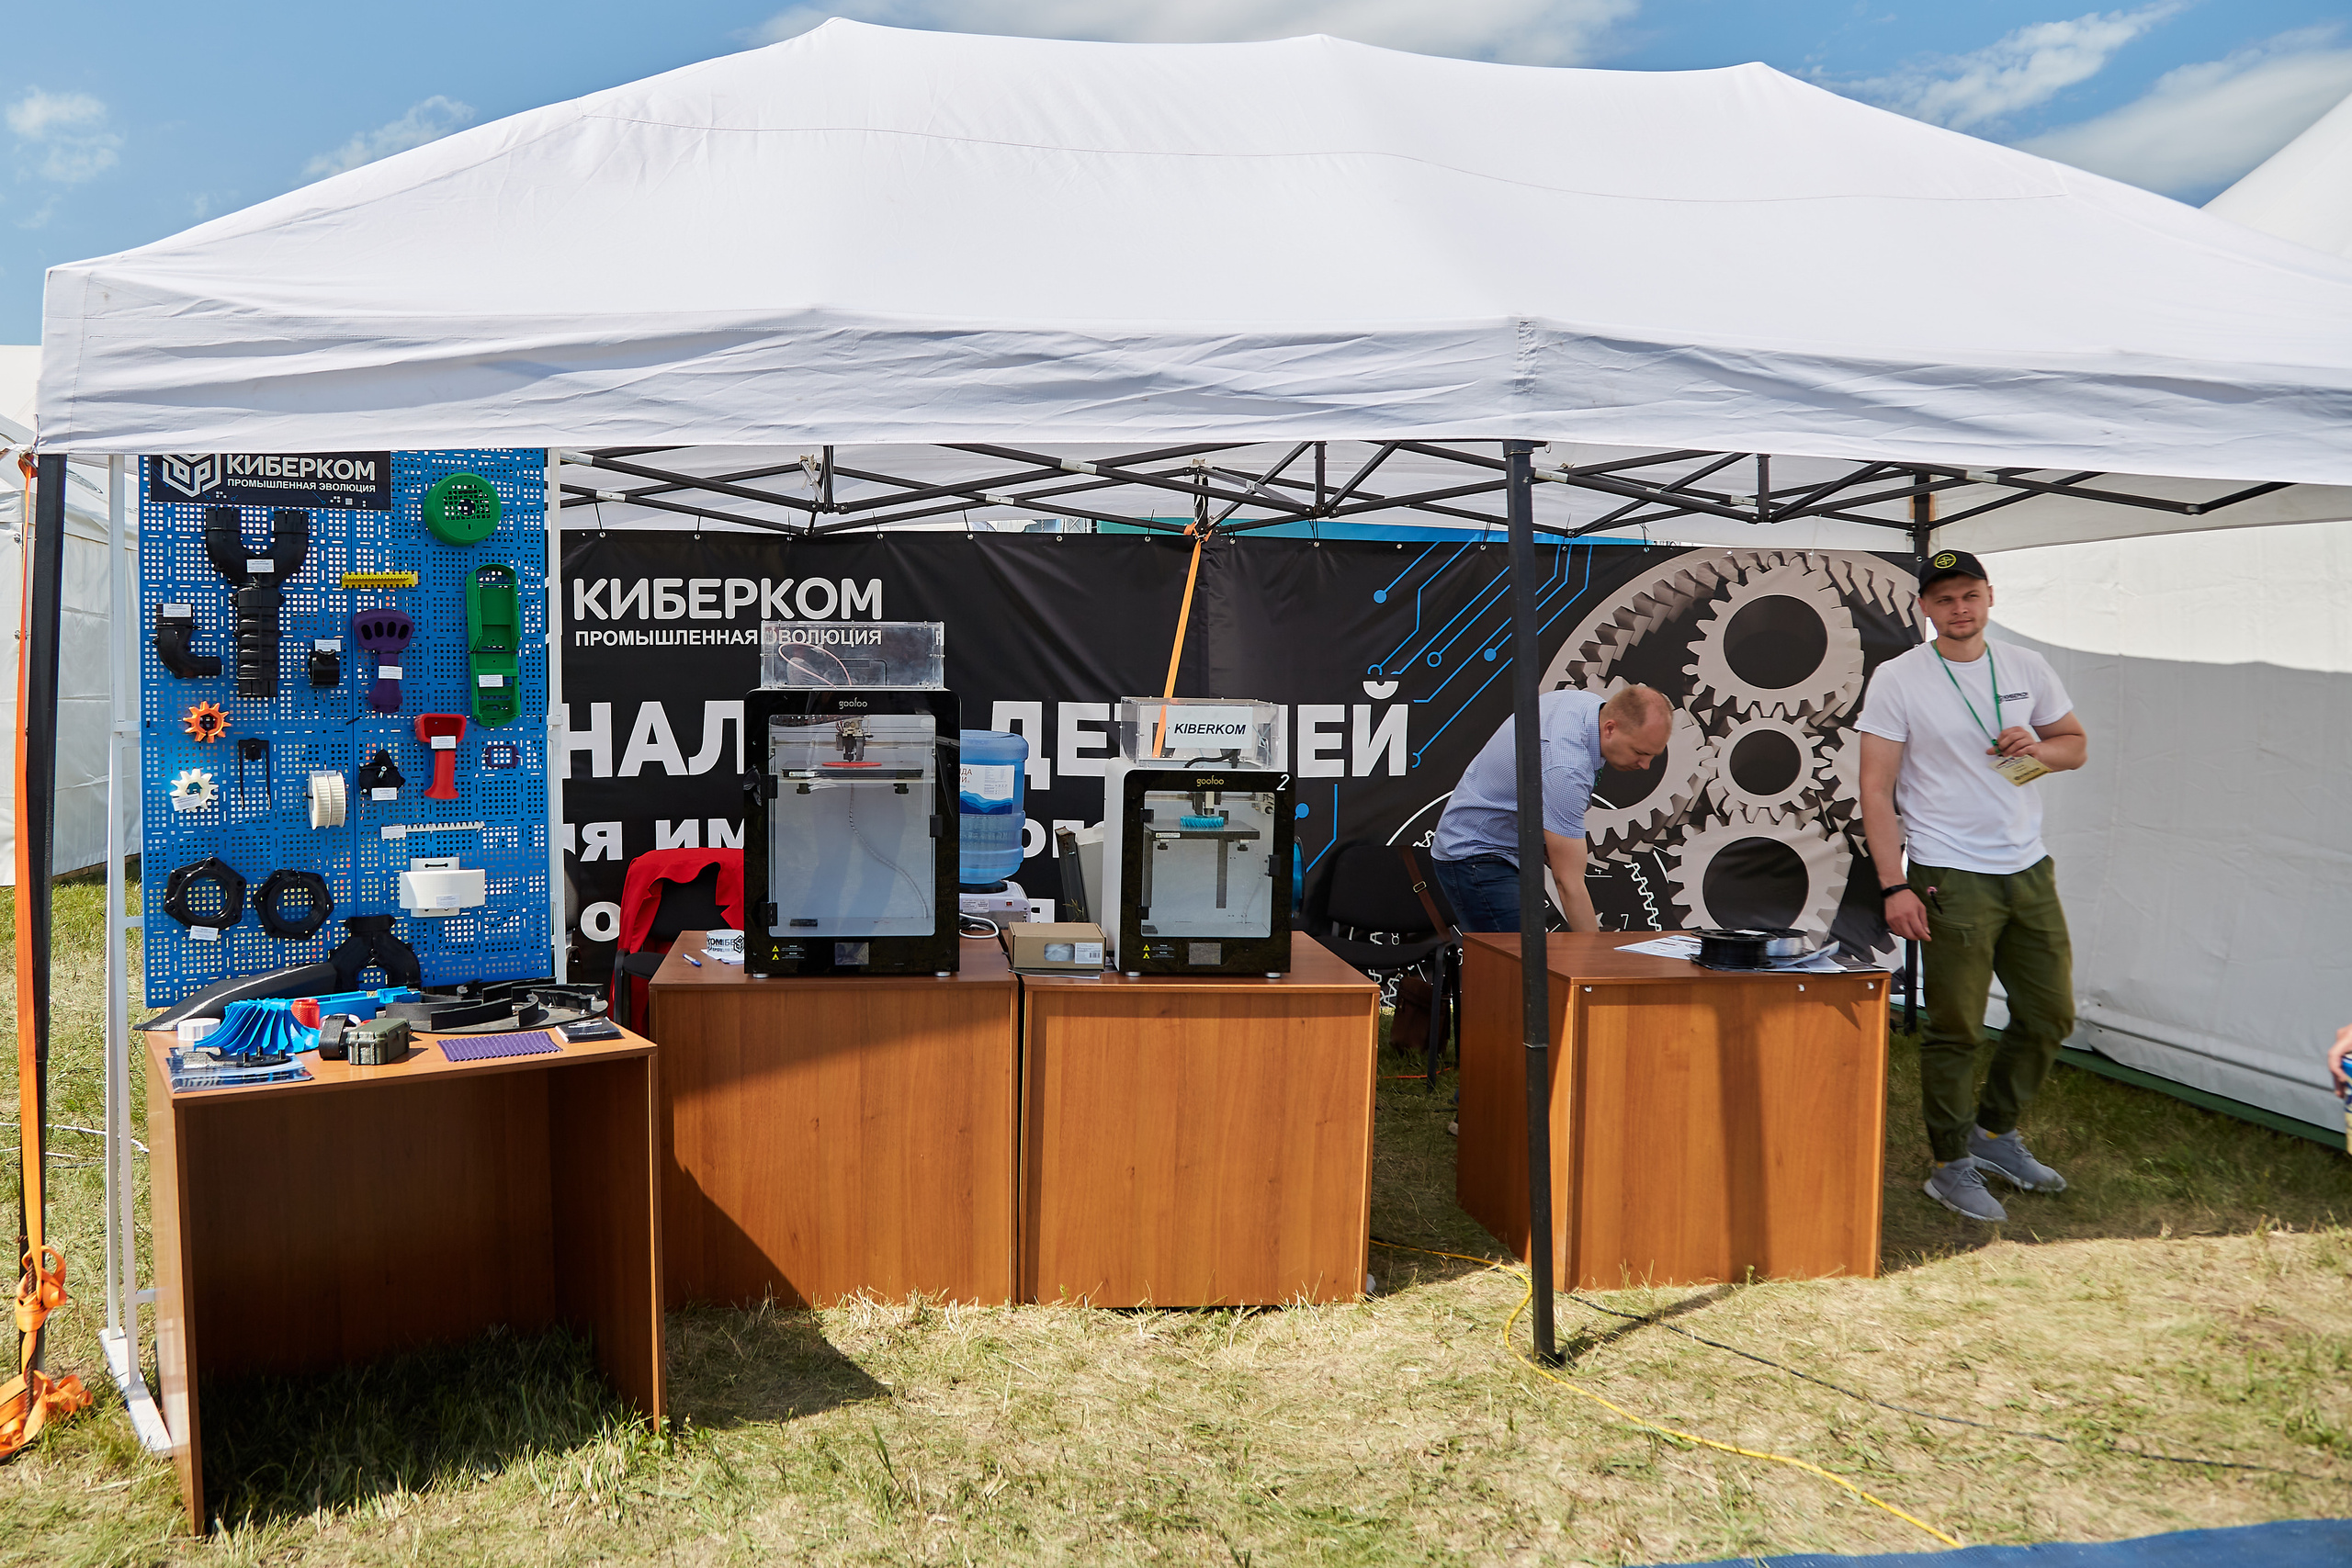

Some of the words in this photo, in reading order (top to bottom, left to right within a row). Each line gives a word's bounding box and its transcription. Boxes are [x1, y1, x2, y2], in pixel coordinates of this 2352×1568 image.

[227, 454, 376, 481] КИБЕРКОМ
[227, 479, 317, 491] ПРОМЫШЛЕННАЯ
[319, 482, 376, 493] ЭВОЛЮЦИЯ
[573, 577, 882, 621] КИБЕРКОМ
[575, 629, 758, 647] ПРОМЫШЛЕННАЯ
[839, 697, 868, 710] goofoo
[561, 700, 744, 779] НАЛ
[990, 681, 1409, 791] ДЕТЛЕЙ
[1174, 723, 1246, 735] KIBERKOM
[1196, 775, 1225, 787] goofoo
